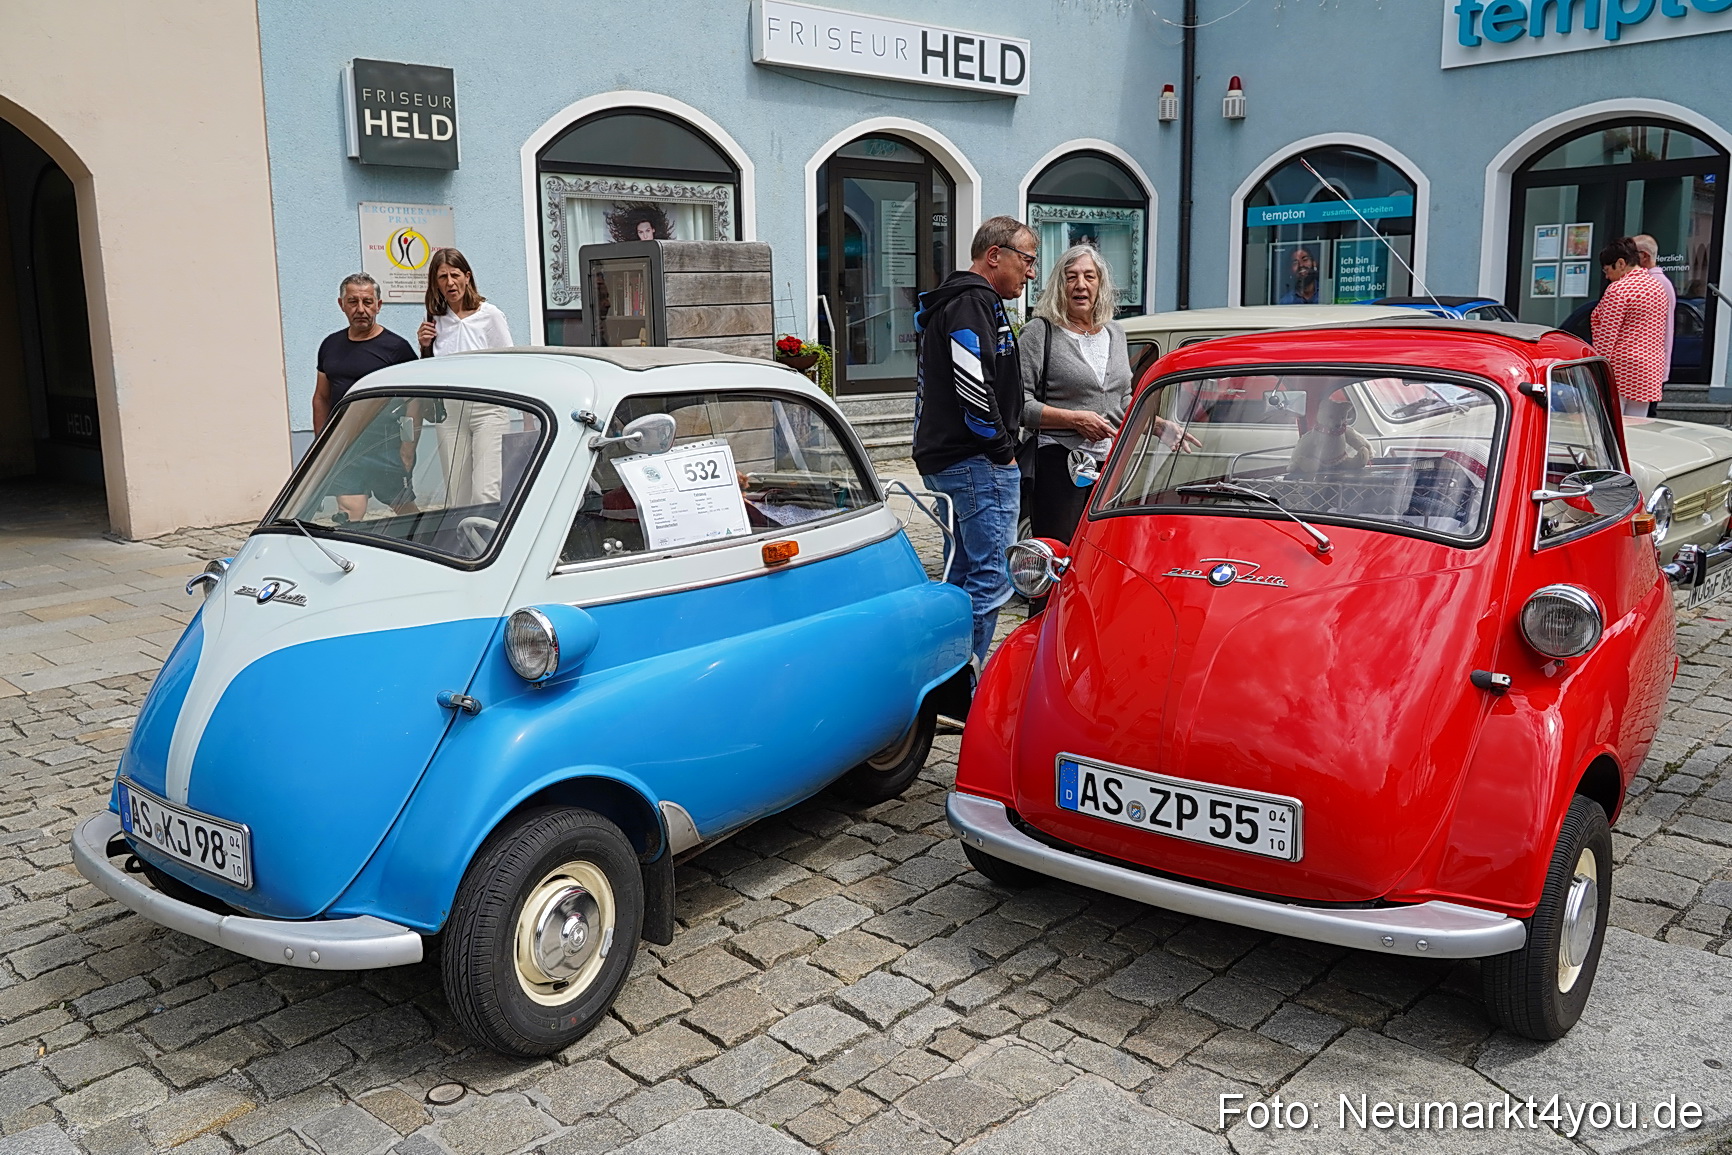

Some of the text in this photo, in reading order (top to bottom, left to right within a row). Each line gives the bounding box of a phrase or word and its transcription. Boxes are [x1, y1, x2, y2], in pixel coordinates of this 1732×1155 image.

[768, 17, 1026, 86] FRISEUR HELD
[362, 88, 452, 109] FRISEUR
[364, 108, 454, 141] HELD
[364, 205, 448, 217] ERGOTHERAPIE
[1262, 209, 1306, 222] tempton
[1363, 205, 1394, 214] arbeiten
[388, 215, 428, 225] PRAXIS
[1341, 256, 1369, 265] Ich bin
[1340, 264, 1379, 274] bereit für
[1340, 275, 1371, 283] meinen
[1340, 282, 1386, 292] neuen Job!
[67, 413, 93, 436] HELD
[682, 459, 721, 482] 532
[1167, 567, 1203, 577] 250
[1065, 772, 1260, 845] D AS ZP 55
[1268, 809, 1287, 824] 04
[131, 794, 153, 839] AS
[161, 810, 192, 858] KJ
[194, 825, 227, 870] 98
[229, 835, 241, 849] 04
[1269, 838, 1286, 851] 10
[232, 864, 242, 877] 10
